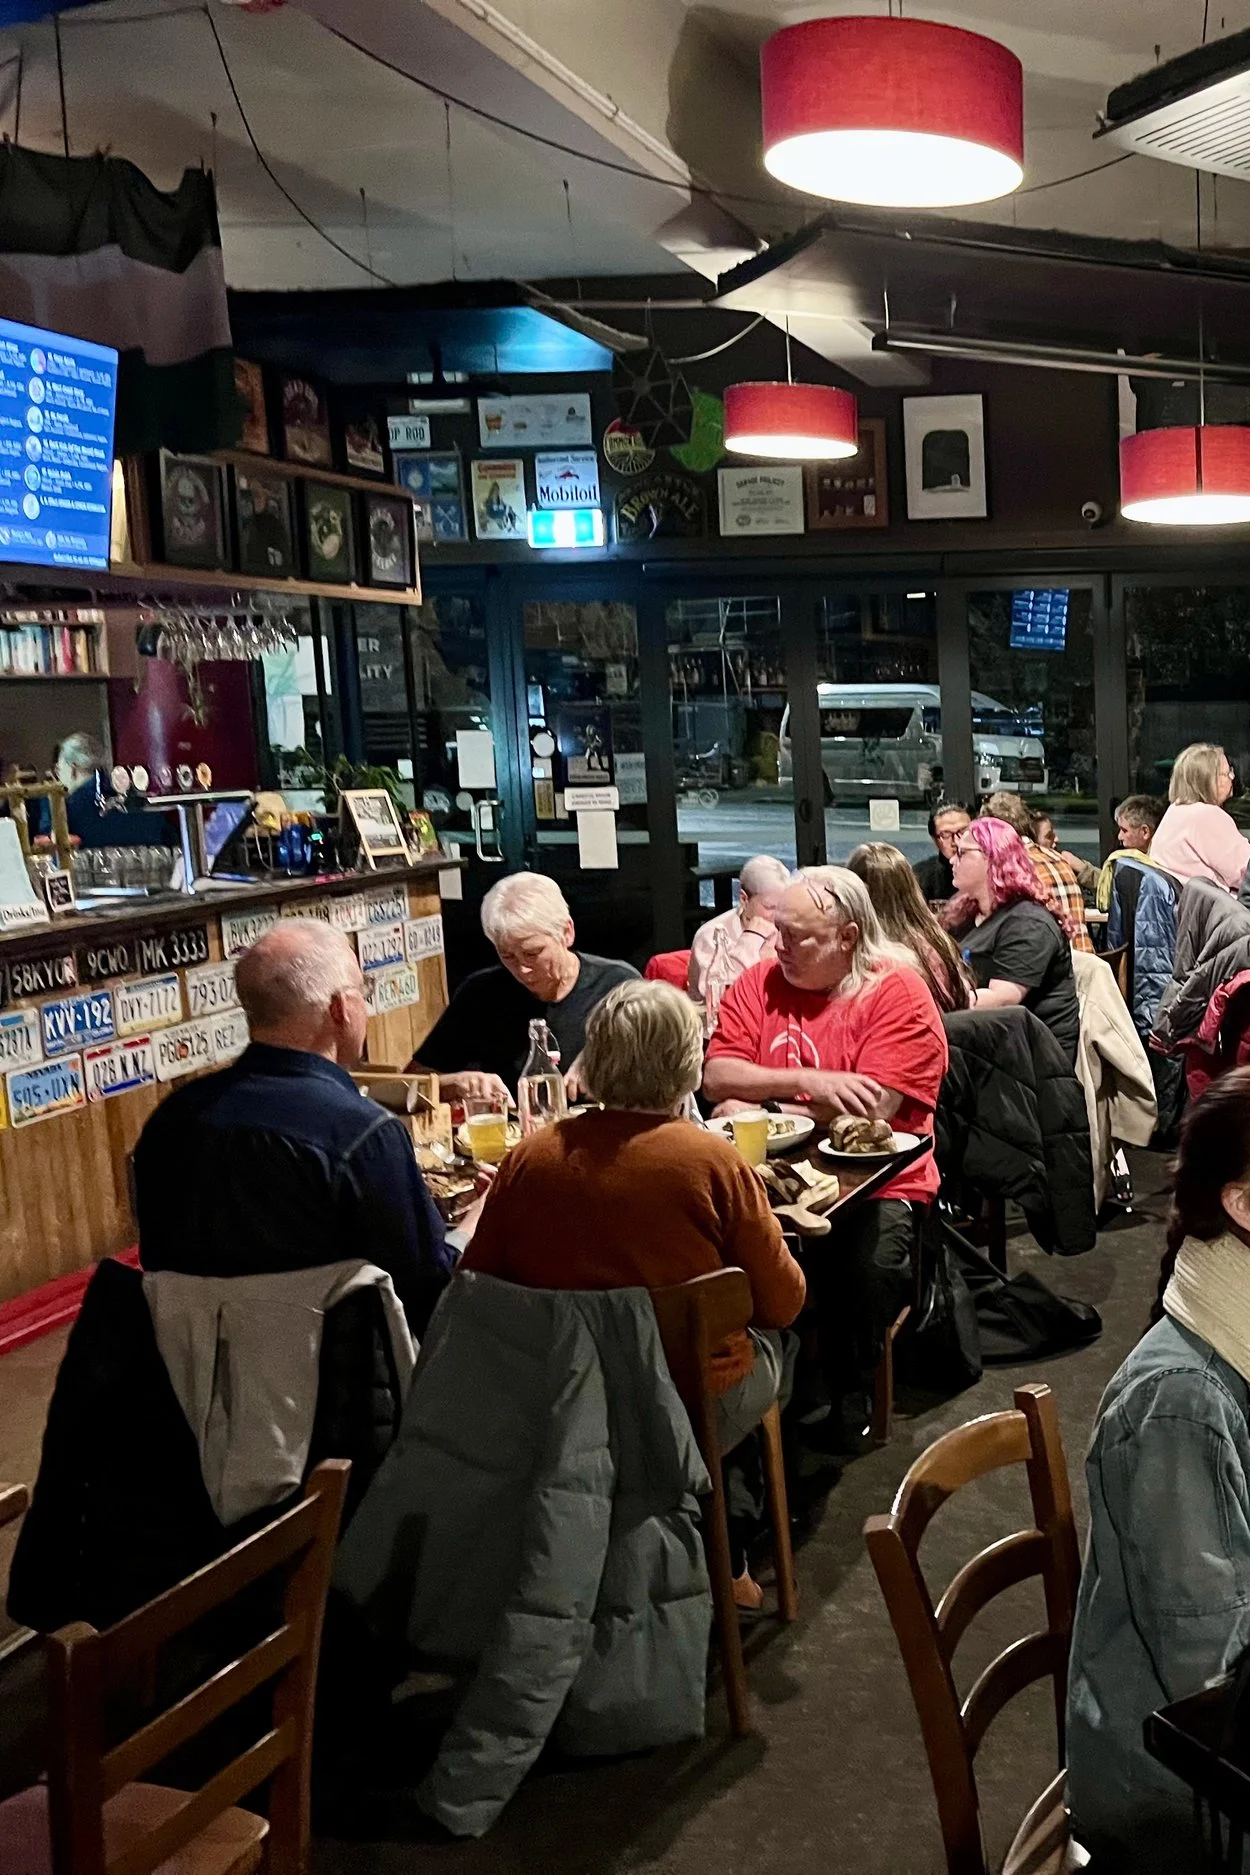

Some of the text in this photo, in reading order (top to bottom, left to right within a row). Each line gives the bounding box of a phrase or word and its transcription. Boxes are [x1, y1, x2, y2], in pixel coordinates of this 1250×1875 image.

[405, 425, 425, 441] ROD
[540, 485, 597, 503] Mobiloil
[620, 488, 669, 523] BROWN
[670, 493, 700, 520] ALE
[140, 929, 207, 971] MK 3333
